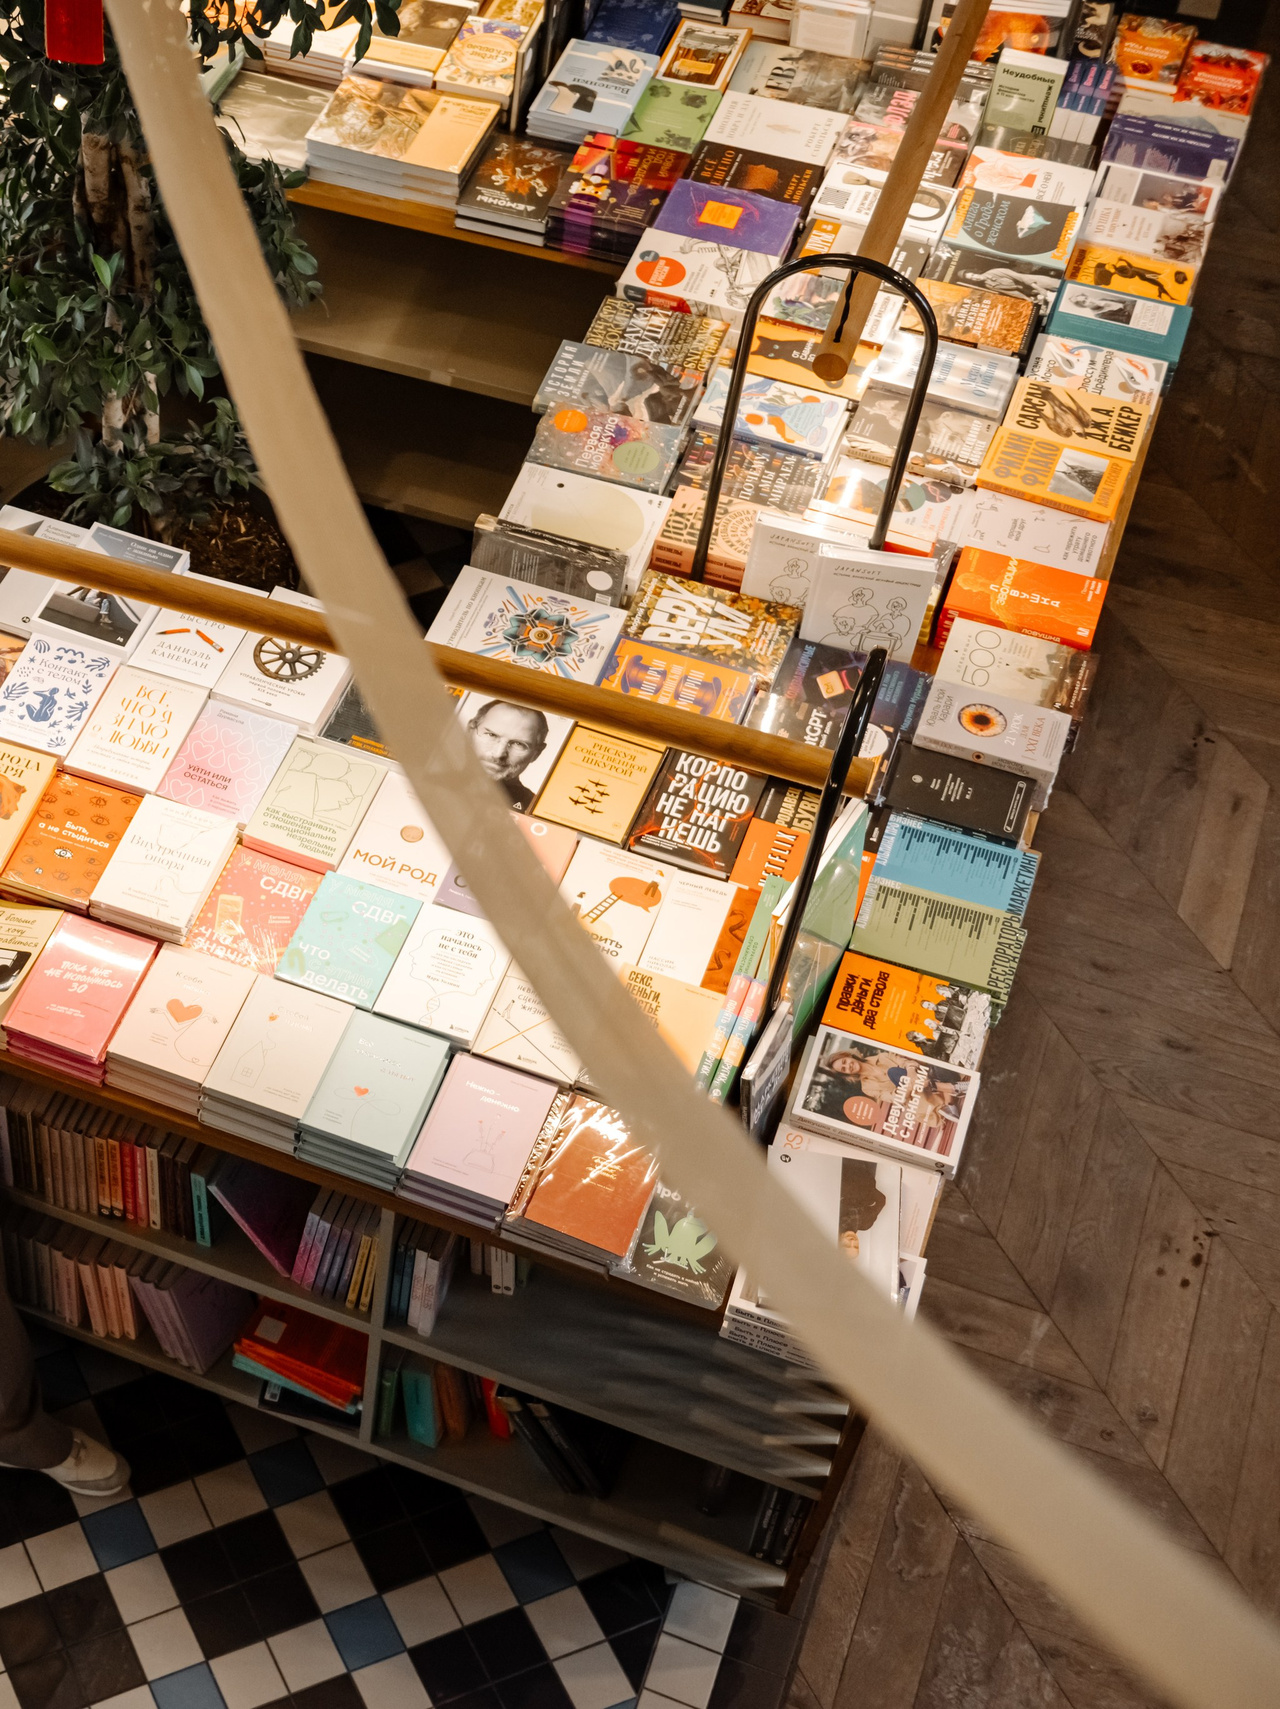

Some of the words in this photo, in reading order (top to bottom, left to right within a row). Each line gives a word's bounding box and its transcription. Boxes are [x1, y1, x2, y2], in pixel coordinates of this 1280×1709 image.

[572, 77, 631, 93] Валенки
[763, 53, 803, 91] ЕВА
[1002, 68, 1056, 85] Неудобные
[803, 122, 821, 148] РОБЕРТ
[652, 148, 665, 164] ГОД
[657, 150, 676, 177] НОВЫЙ
[700, 156, 718, 178] ВСЁ
[626, 152, 654, 196] РОЖДЕСТВО
[783, 173, 801, 200] РОБЕРТ
[959, 200, 981, 231] Книга
[973, 199, 998, 231] Граде
[982, 197, 1013, 246] женском
[1048, 208, 1083, 262] Кристина
[953, 297, 971, 328] ТАЙНАЯ
[963, 301, 982, 328] ЖИЗНЬ
[970, 297, 994, 336] ДЕРЕВЬЕВ
[617, 303, 654, 353] НАУКА
[634, 308, 672, 360] ДУШИ
[1015, 381, 1051, 429] САПСАН
[1105, 405, 1143, 453] БЕЙКЕР
[576, 424, 603, 468] Первая
[592, 417, 618, 470] молекула
[991, 430, 1034, 479] ФИЛИН
[1018, 439, 1060, 486] ФЛАКО
[739, 452, 769, 500] ПОЧЕМУ
[1012, 530, 1022, 542] мой
[1016, 517, 1028, 531] друг
[641, 578, 716, 645] ВЕРХ
[151, 650, 209, 670] КАНЕМАН
[157, 641, 212, 662] ДАНИЭЛЬ
[958, 626, 1006, 690] 500
[39, 658, 88, 680] Контакт
[46, 670, 82, 686] телом
[238, 671, 286, 691] УПРАВЛЕНЧЕСКИЕ
[286, 687, 303, 697] УРОКИ
[933, 687, 946, 703] Ной
[925, 702, 942, 727] Юваль
[937, 694, 956, 723] Харари
[1007, 711, 1024, 734] УРОК
[1030, 715, 1046, 737] ВЕКА
[592, 742, 636, 762] РИСКУЯ
[1004, 734, 1017, 746] 21
[574, 744, 647, 775] СОБСТВЕННОЙ
[581, 754, 633, 778] ШКУРОЙ
[676, 752, 750, 791] КОРПО
[184, 772, 229, 791] ОСТАТЬСЯ
[187, 763, 209, 778] УЙТИ
[212, 772, 232, 784] ИЛИ
[668, 775, 749, 815] РАЦИЮ
[266, 806, 280, 815] как
[282, 810, 337, 834] выстраивать
[656, 791, 690, 816] НЕ
[690, 804, 737, 832] НАГ
[890, 814, 923, 829] БИЗНЕС
[48, 825, 60, 833] не
[62, 828, 110, 850] стыдиться
[65, 820, 90, 836] Быть,
[658, 816, 721, 853] НЕШЬ
[286, 832, 336, 853] незрелыми
[299, 843, 334, 858] людьми
[875, 834, 895, 865] АЛЬПИНА
[886, 820, 899, 835] ПРО
[353, 849, 396, 872] МОЙ
[400, 865, 438, 888] РОД
[758, 831, 799, 888] NETFLIX
[260, 875, 314, 902] СДВГ
[678, 880, 703, 891] ЧЕРНЫЙ
[705, 886, 728, 897] ЛЕБЕДЬ
[865, 881, 878, 895] ПРО
[870, 875, 902, 890] БИЗНЕС
[1008, 852, 1040, 914] МАРКЕТИНГ
[5, 912, 37, 926] больше
[352, 900, 407, 926] СДВГ
[6, 926, 26, 936] хочу
[441, 934, 482, 952] началось
[456, 930, 474, 940] ЭТО
[439, 942, 450, 950] не
[458, 948, 478, 959] тебя
[44, 968, 62, 978] НЕ
[63, 971, 123, 989] ИСПОЛНИЛОСЬ
[60, 961, 87, 974] ПОКА
[91, 965, 113, 978] МНЕ
[628, 970, 654, 988] СЕКС,
[68, 983, 88, 994] 30
[863, 1007, 877, 1030] два
[870, 971, 890, 1007] ствола
[465, 1081, 495, 1095] Нежно
[906, 1066, 930, 1130] деньгами
[480, 1095, 519, 1113] денежно
[883, 1076, 911, 1135] Девушка
[760, 1325, 786, 1338] Плюсе
